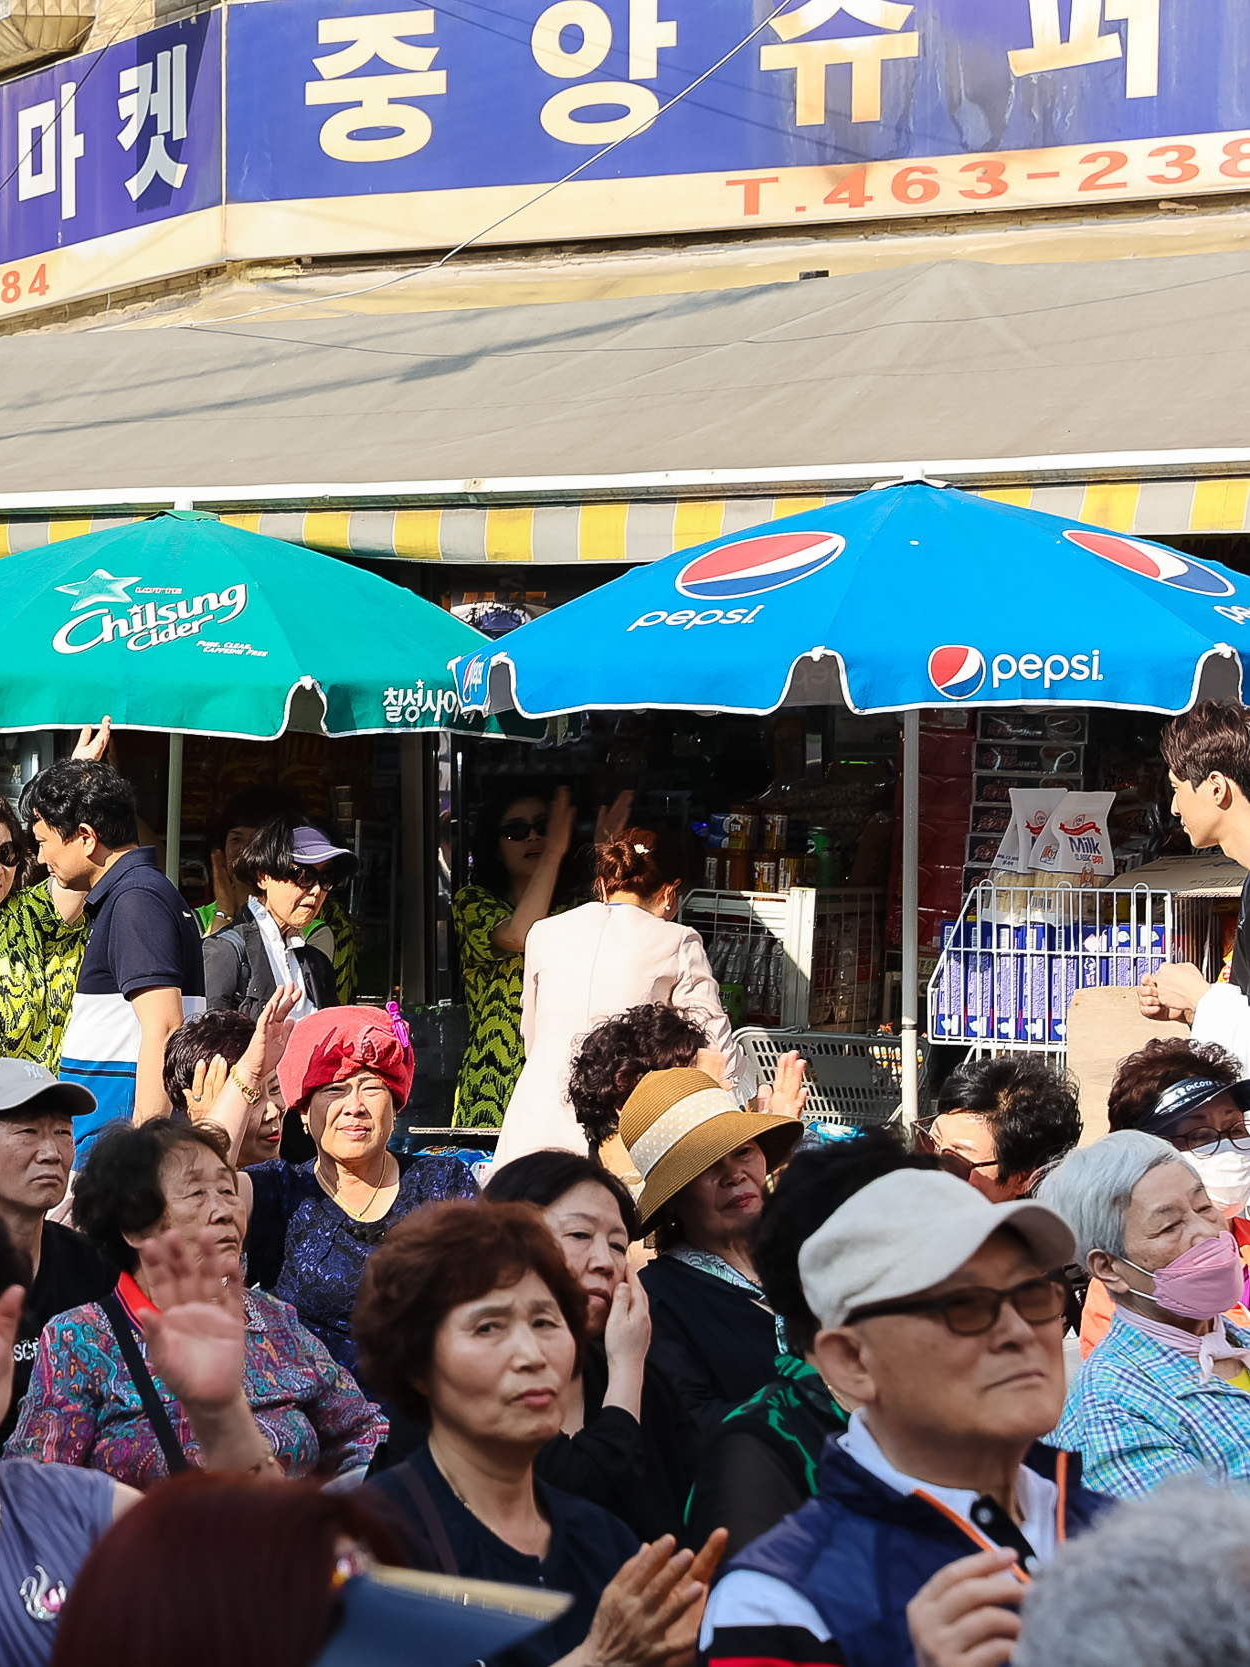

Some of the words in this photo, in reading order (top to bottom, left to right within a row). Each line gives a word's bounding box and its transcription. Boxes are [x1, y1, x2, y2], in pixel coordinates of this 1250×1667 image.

[52, 583, 249, 655] Chilsung
[626, 603, 766, 632] pepsi
[992, 649, 1102, 688] pepsi
[1068, 836, 1102, 855] Milk
